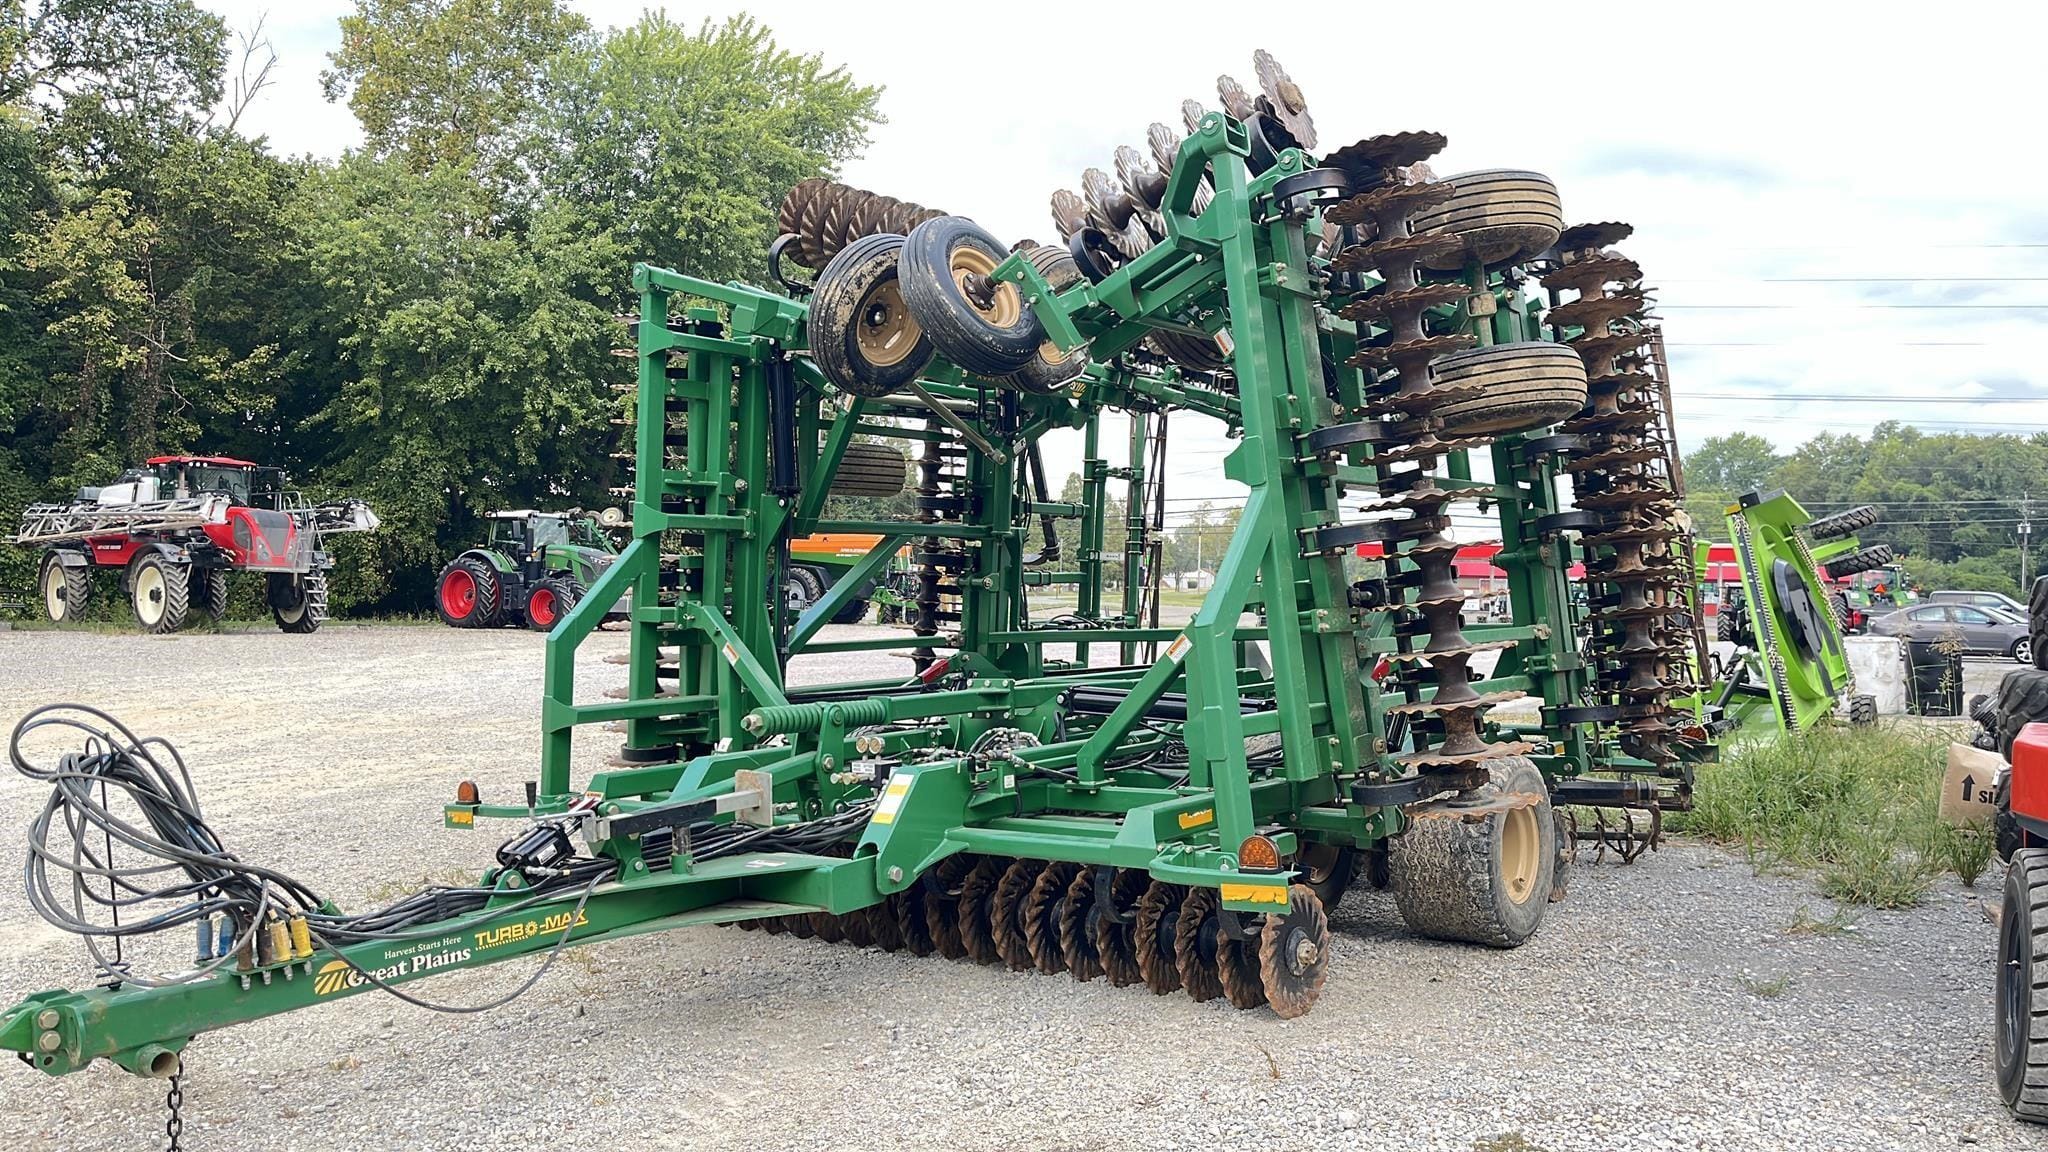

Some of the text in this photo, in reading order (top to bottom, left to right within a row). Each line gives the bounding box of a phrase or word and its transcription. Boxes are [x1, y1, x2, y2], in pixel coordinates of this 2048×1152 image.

[384, 936, 462, 960] Harvest Starts Here
[347, 948, 472, 987] Great Plains
